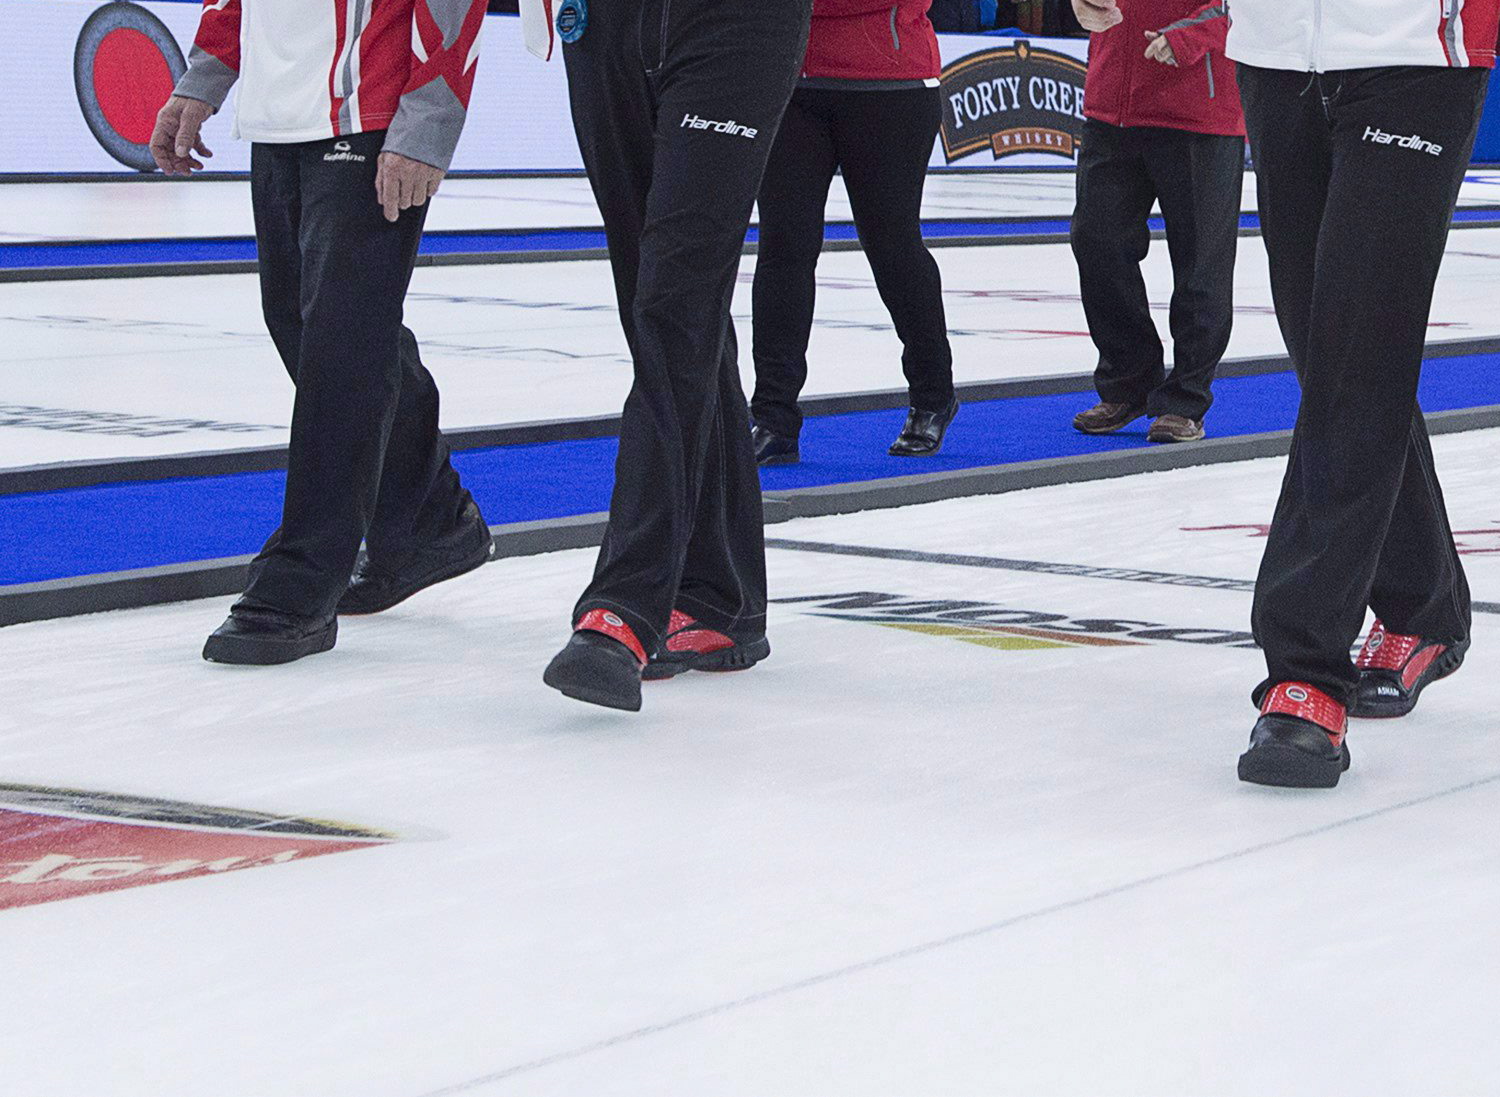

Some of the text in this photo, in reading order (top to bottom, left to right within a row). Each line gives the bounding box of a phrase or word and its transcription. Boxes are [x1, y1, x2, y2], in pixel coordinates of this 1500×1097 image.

[949, 76, 1020, 129] FORTY
[680, 113, 758, 139] Hardline
[1002, 132, 1063, 147] WHISKY
[1362, 126, 1443, 156] Hardline
